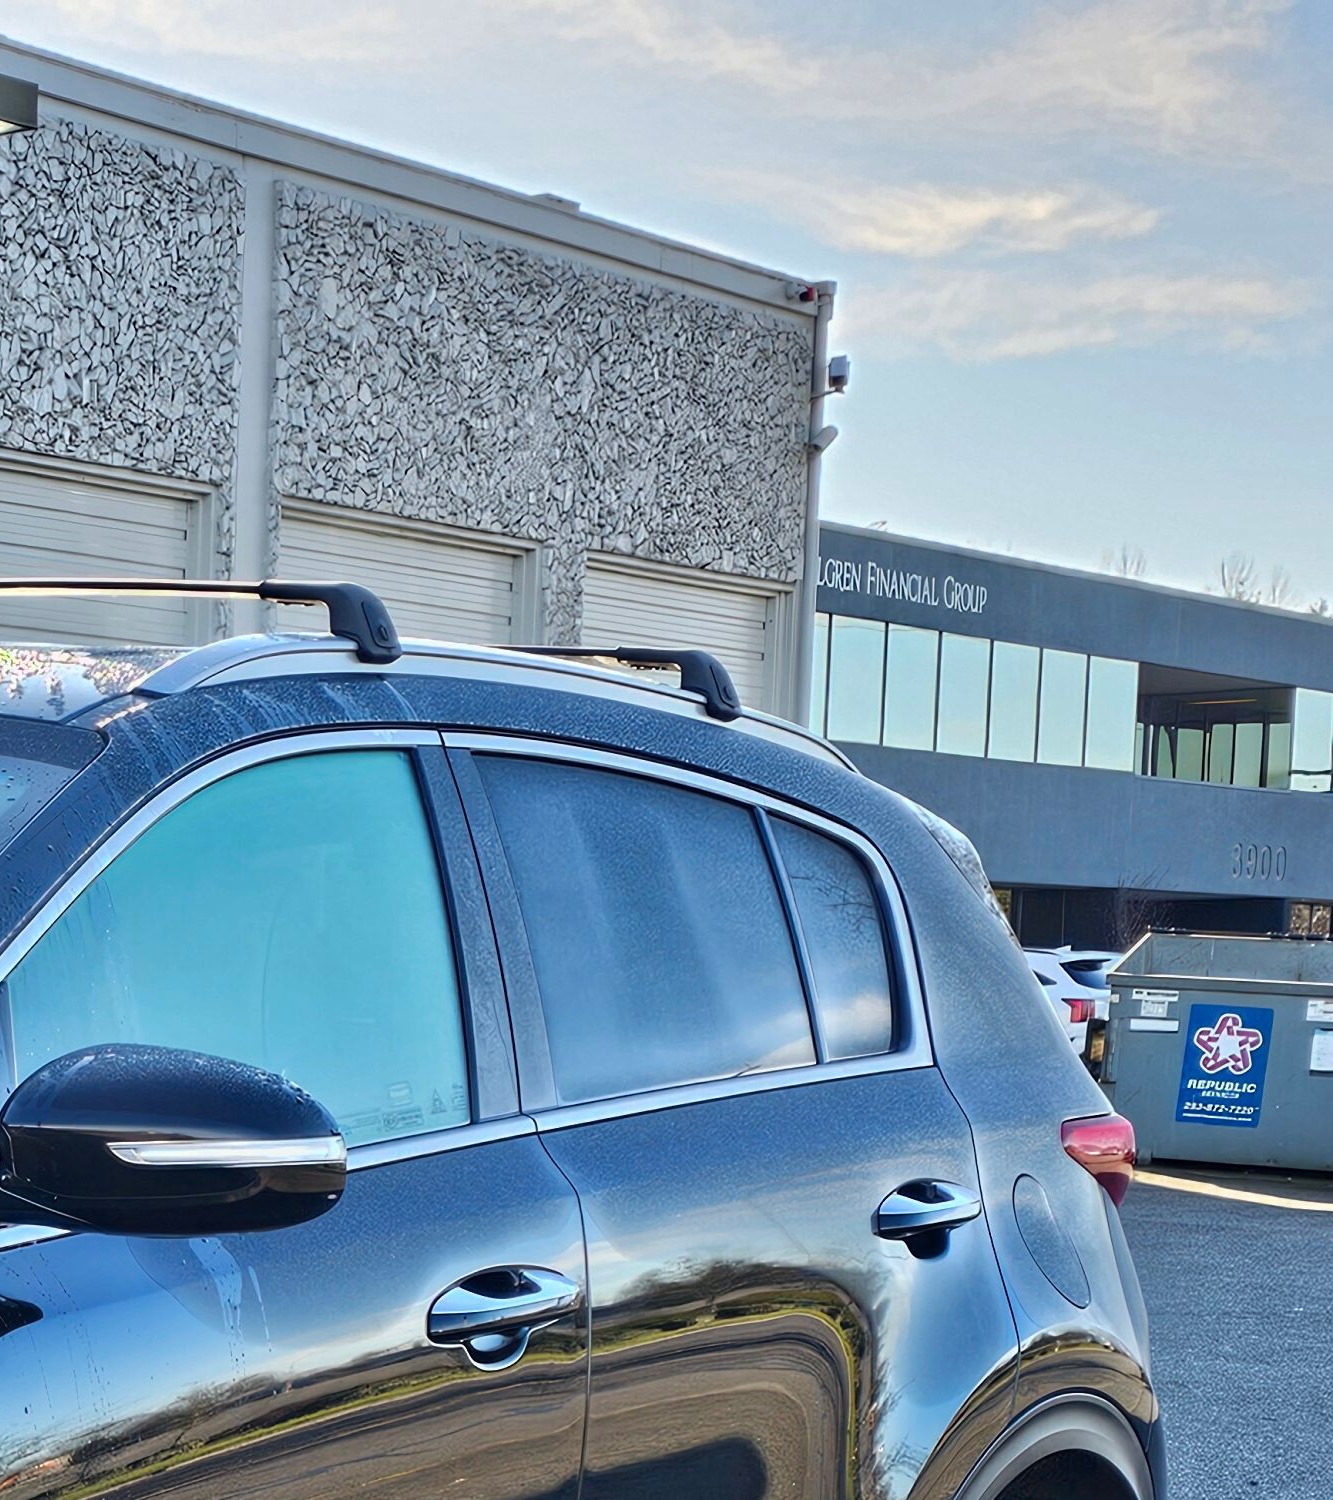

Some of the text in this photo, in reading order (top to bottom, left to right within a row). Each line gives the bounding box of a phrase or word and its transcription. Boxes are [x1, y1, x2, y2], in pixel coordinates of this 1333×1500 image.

[866, 561, 939, 607] FINANCIAL
[943, 576, 988, 614] GROUP
[1232, 843, 1287, 881] 3900
